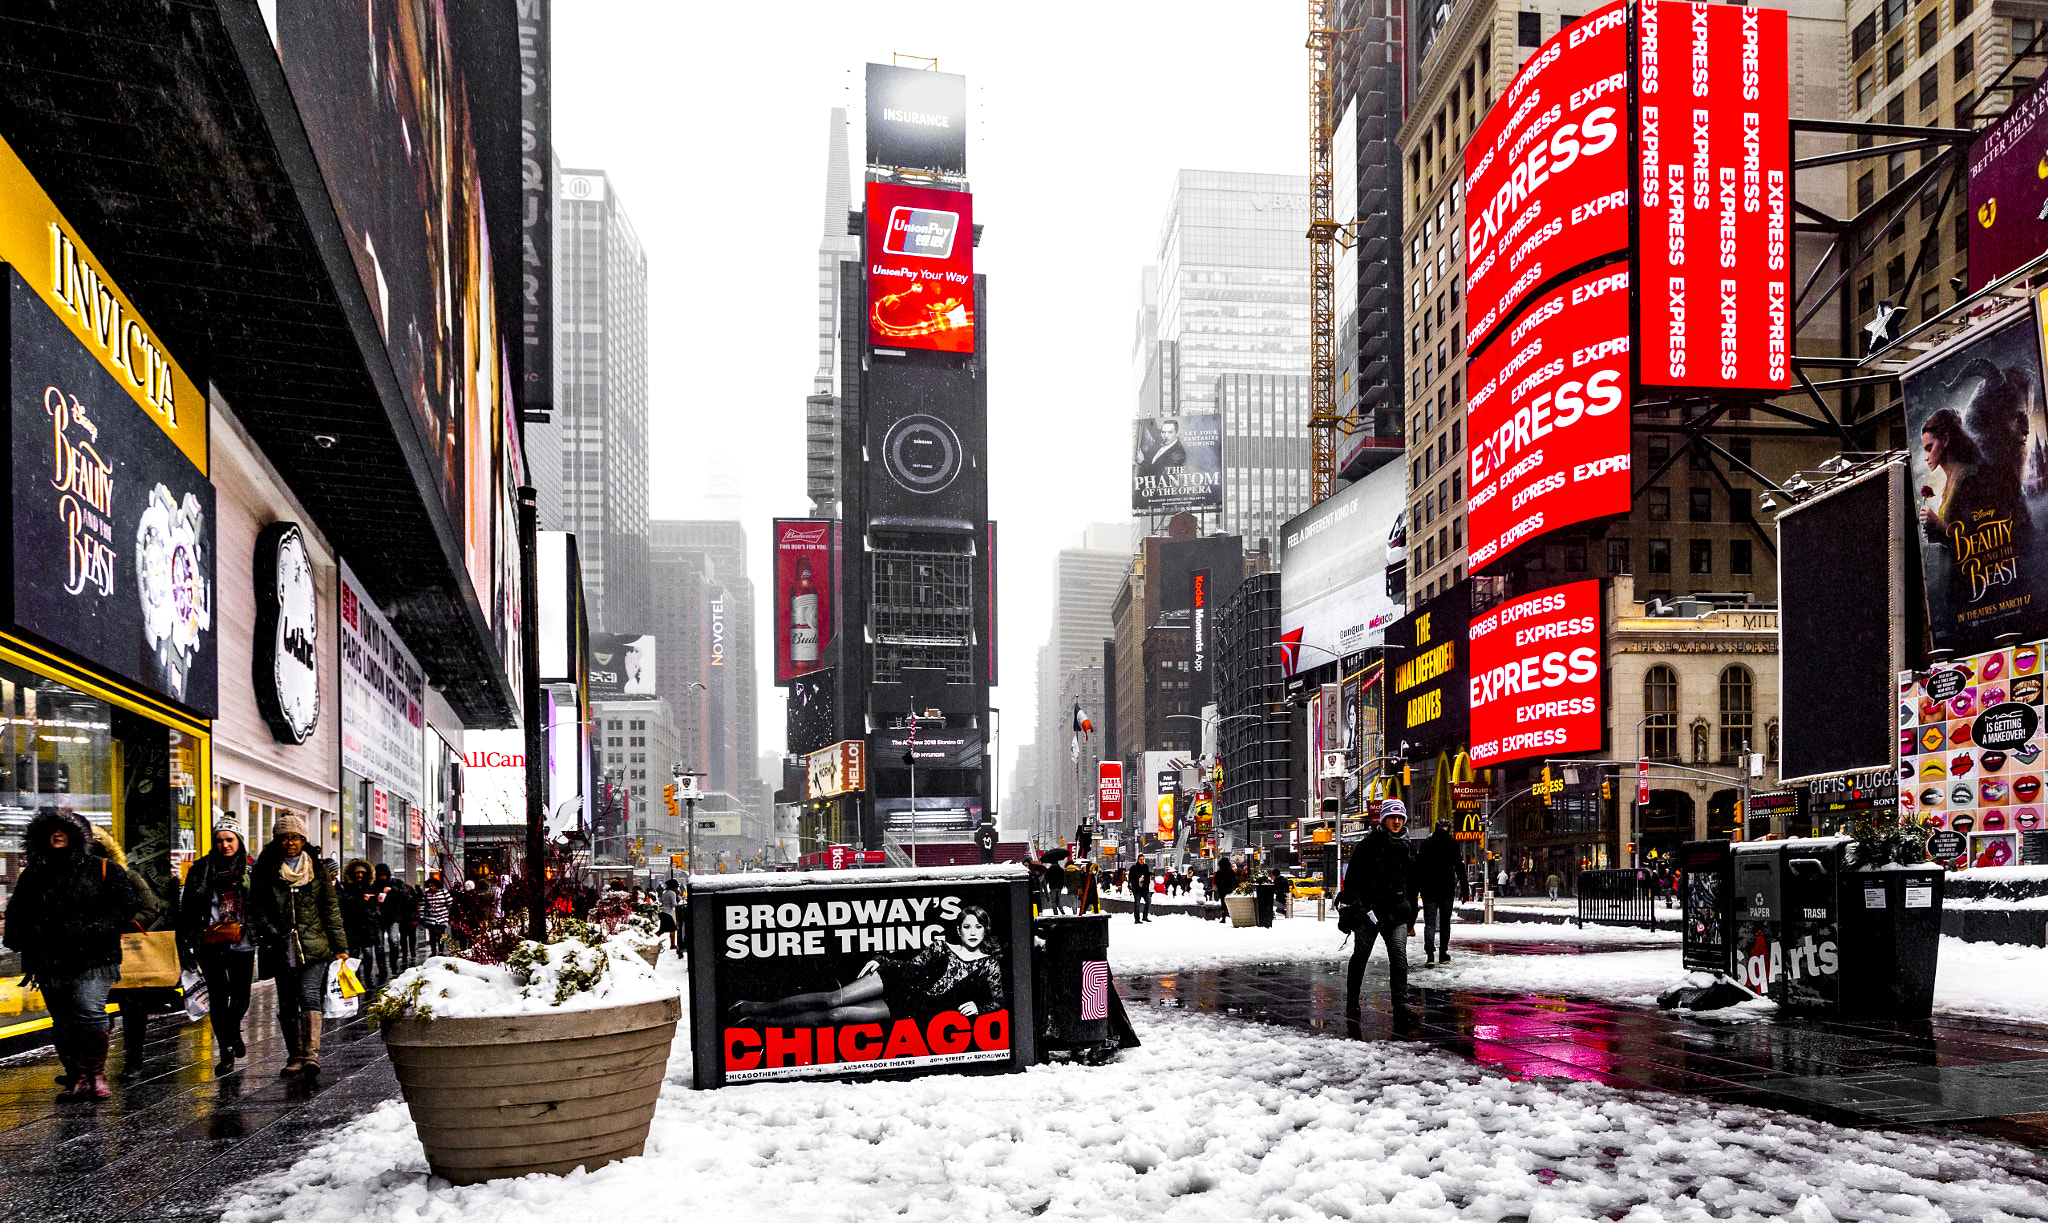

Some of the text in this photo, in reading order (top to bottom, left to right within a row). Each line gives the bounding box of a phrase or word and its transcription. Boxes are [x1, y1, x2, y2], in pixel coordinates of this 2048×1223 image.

[1508, 42, 1561, 108] EXPRESS
[883, 107, 950, 128] INSURANCE
[1497, 88, 1541, 152] EXPRESS
[1508, 104, 1562, 166] EXPRESS
[1985, 127, 2001, 152] IT'S
[2003, 100, 2029, 134] BACK
[2031, 80, 2048, 108] AN
[2007, 108, 2036, 144] THAN
[1642, 106, 1659, 207] EXPRESS
[1693, 109, 1709, 210] EXPRESS
[1743, 112, 1760, 212] EXPRESS
[1468, 106, 1617, 266] EXPRESS
[894, 218, 951, 243] UnionPay
[1498, 199, 1542, 256] EXPRESS
[1510, 188, 1629, 273] EXPRESS EXPR
[873, 264, 968, 285] UnionPay Your Way
[1498, 262, 1542, 314] EXPRESS
[1668, 164, 1686, 378] EXPRESS EXPRESS
[1719, 167, 1737, 380] EXPRESS EXPRESS
[1768, 170, 1785, 382] EXPRESS EXPRESS
[48, 221, 178, 429] INVICTA
[1511, 271, 1629, 347] EXPRESS EXPR
[1499, 338, 1543, 386] EXPRESS
[1511, 358, 1564, 405] EXPRESS
[1471, 369, 1622, 487] EXPRESS
[44, 386, 114, 518] BEAUTY
[1165, 466, 1187, 474] THE
[1499, 449, 1544, 491] EXPRESS
[1134, 472, 1219, 491] PHANTOM
[1141, 485, 1212, 497] OF THE OPERA
[1512, 453, 1630, 512] EXPRESS EXPR
[59, 495, 117, 596] BEAST
[1287, 498, 1359, 549] FEEL A DIFFERENT KIND OF
[1500, 512, 1544, 550] EXPRESS
[1946, 511, 2013, 565] BEAUTY
[1961, 556, 2019, 603] BEAST
[711, 594, 723, 666] NOVOTEL
[1194, 575, 1204, 672] Kodak Moments App
[1415, 611, 1431, 647] THE
[1501, 593, 1566, 626] EXPRESS
[1516, 616, 1595, 647] EXPRESS
[1958, 613, 1965, 623] IN
[1967, 606, 1997, 621] THEATRES
[1999, 597, 2023, 611] MARCH
[791, 632, 818, 645] Bud
[1395, 640, 1455, 694] FINAL DEFENDER
[1470, 647, 1598, 709] EXPRESS
[1406, 688, 1442, 729] ARRIVES
[1516, 696, 1596, 723] EXPRESS
[1986, 718, 2022, 732] IS GETTING
[1502, 727, 1567, 752] EXPRESS
[1982, 729, 2026, 744] A MAKEOVER!
[848, 743, 859, 788] HELLO!
[1532, 779, 1563, 796] EXPESS
[1810, 777, 1846, 795] GIFTS
[1751, 795, 1795, 808] ELECTRONICS
[1861, 789, 1874, 798] NY
[1873, 798, 1896, 806] SONY
[832, 848, 843, 870] tkts
[725, 896, 962, 930] BROADWAY'S
[1750, 907, 1770, 917] PAPER
[1803, 908, 1826, 919] TRASH
[725, 924, 946, 960] SURE THING
[724, 1009, 1010, 1072] CHICAGO
[889, 1059, 915, 1067] THEATRE
